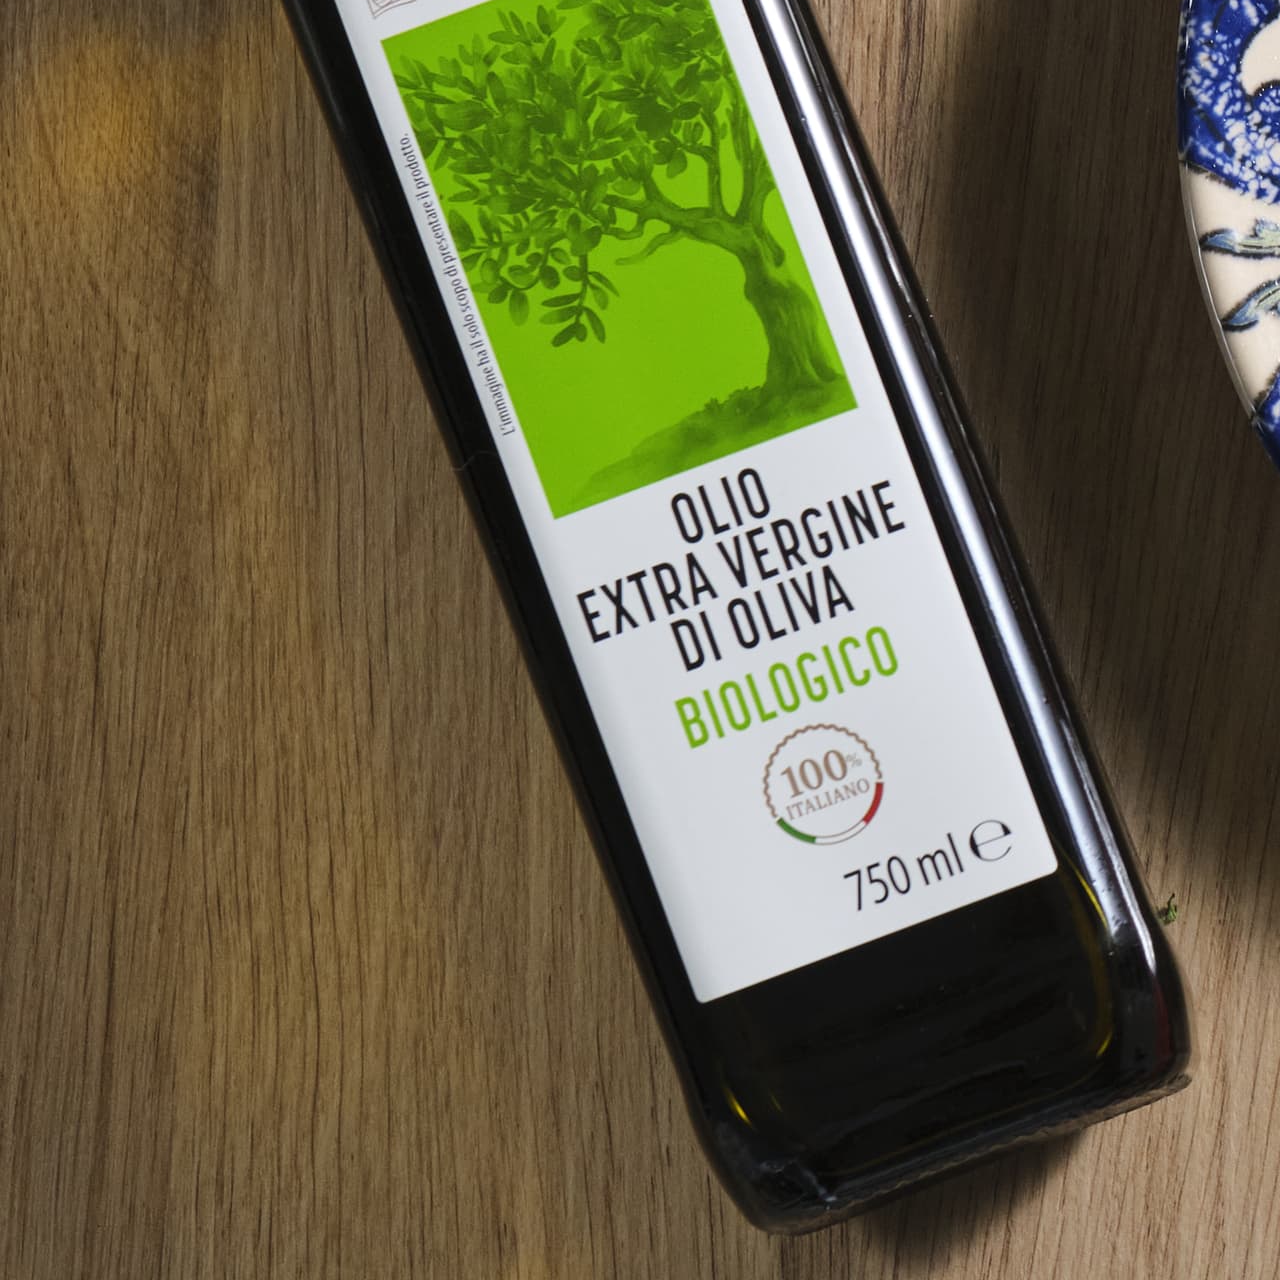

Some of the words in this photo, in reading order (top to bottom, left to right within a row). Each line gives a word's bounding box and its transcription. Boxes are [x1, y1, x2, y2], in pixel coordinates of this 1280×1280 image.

[400, 132, 430, 189] prodotto.
[415, 191, 429, 200] il
[422, 201, 456, 263] presentare
[443, 265, 458, 277] di
[451, 278, 471, 313] scopo
[463, 313, 480, 339] solo
[469, 339, 485, 350] il
[477, 349, 490, 367] ha
[483, 366, 516, 436] L'immagine
[671, 467, 771, 544] OLIO
[576, 553, 718, 643] EXTRA
[717, 480, 905, 588] VERGINE
[670, 615, 722, 672] DI
[727, 564, 855, 650] OLIVA
[674, 625, 899, 748] BIOLOGICO
[781, 749, 863, 799] 100%
[786, 778, 870, 821] ITALIANO
[844, 857, 911, 911] 750
[916, 832, 964, 886] ml
